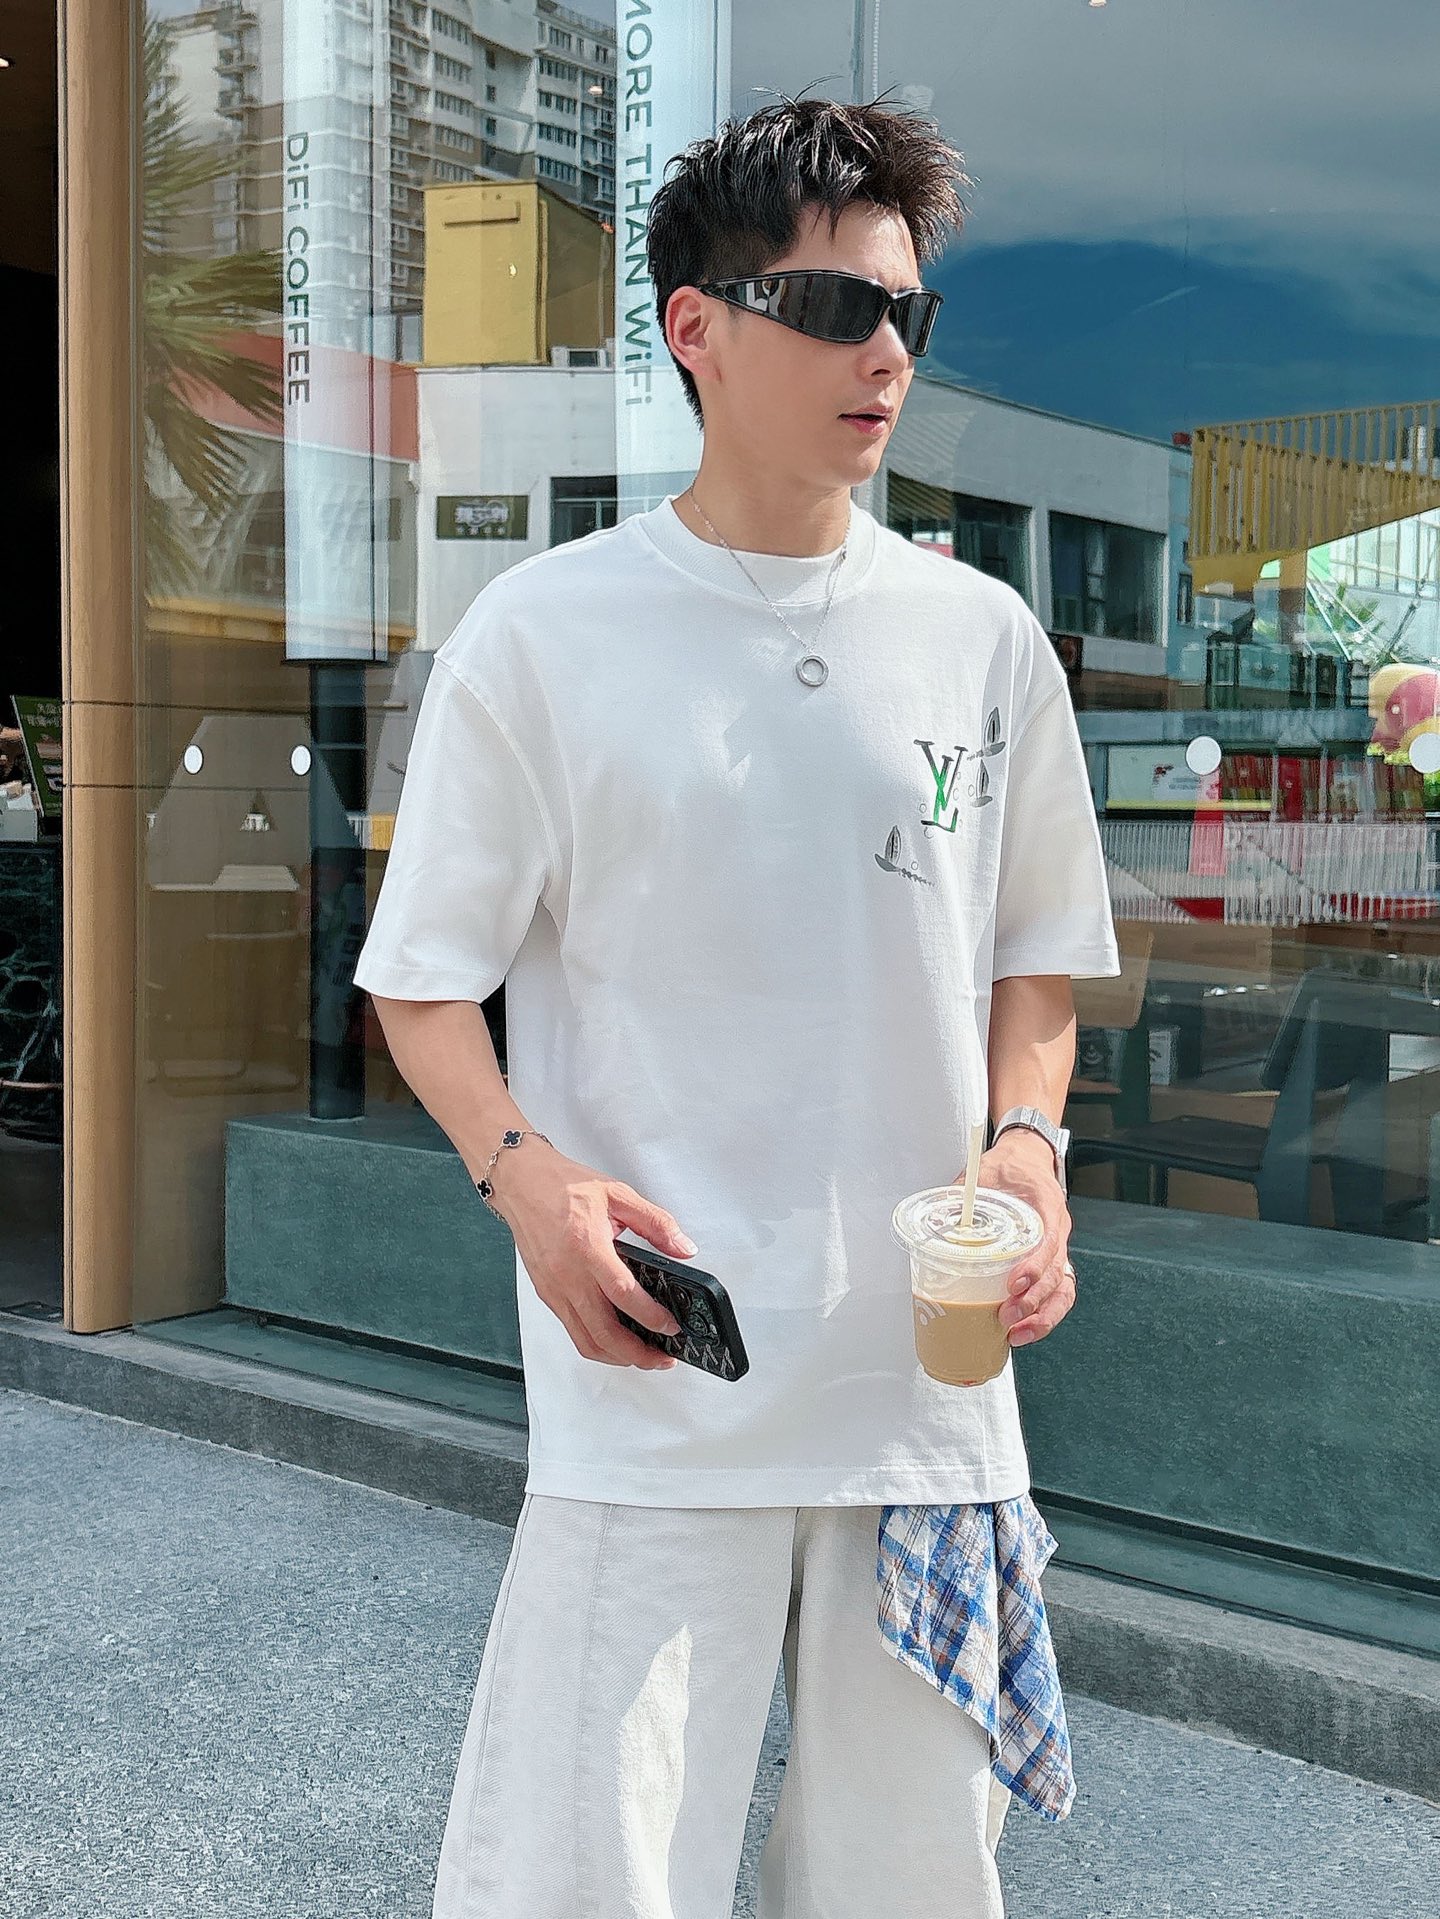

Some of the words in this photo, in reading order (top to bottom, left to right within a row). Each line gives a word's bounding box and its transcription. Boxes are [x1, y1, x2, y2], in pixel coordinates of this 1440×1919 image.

[287, 132, 309, 212] DiFi
[625, 143, 652, 286] THAN
[287, 226, 310, 406] COFFEE
[625, 302, 652, 405] WiFi
